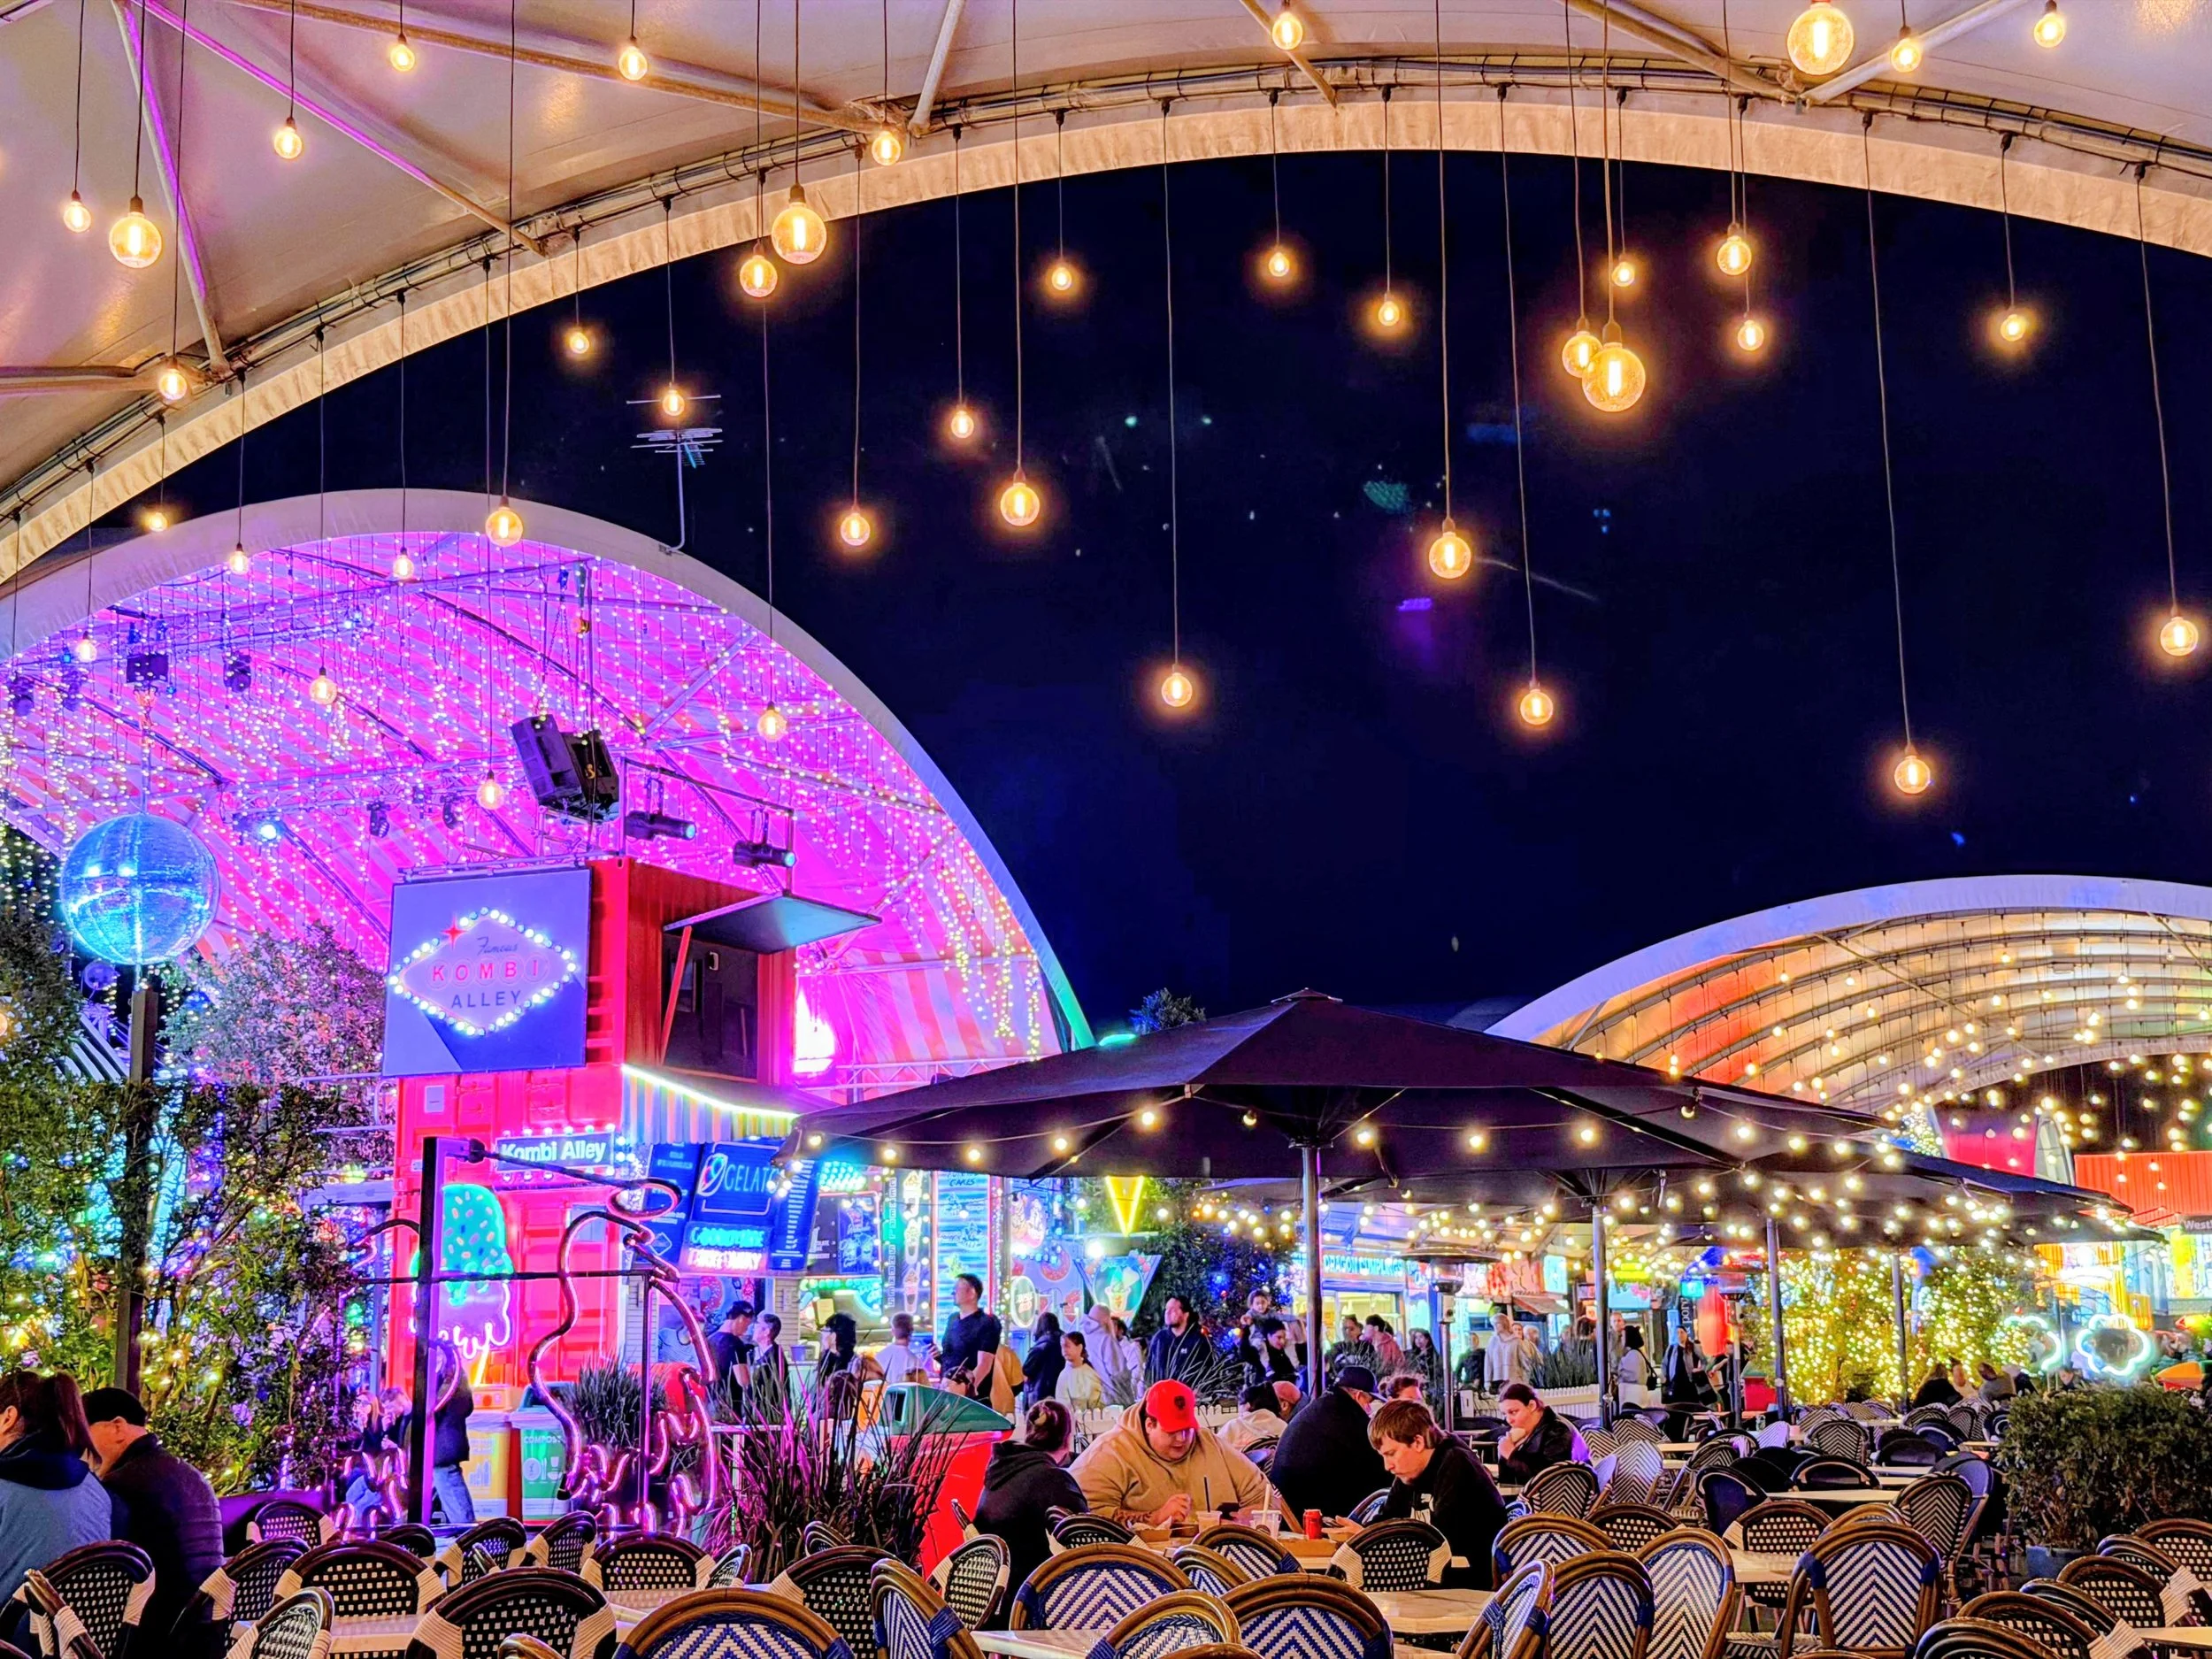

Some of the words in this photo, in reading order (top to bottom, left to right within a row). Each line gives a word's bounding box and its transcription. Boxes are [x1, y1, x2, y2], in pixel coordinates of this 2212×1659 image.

[477, 936, 518, 956] Famous
[432, 960, 538, 982] KOMBI
[450, 989, 521, 1009] ALLEY
[501, 1141, 557, 1162] Kombi
[560, 1140, 607, 1164] Alley
[724, 1164, 779, 1194] GELATO
[1323, 1255, 1359, 1274] DRAGON
[524, 1435, 562, 1444] COMPOST
